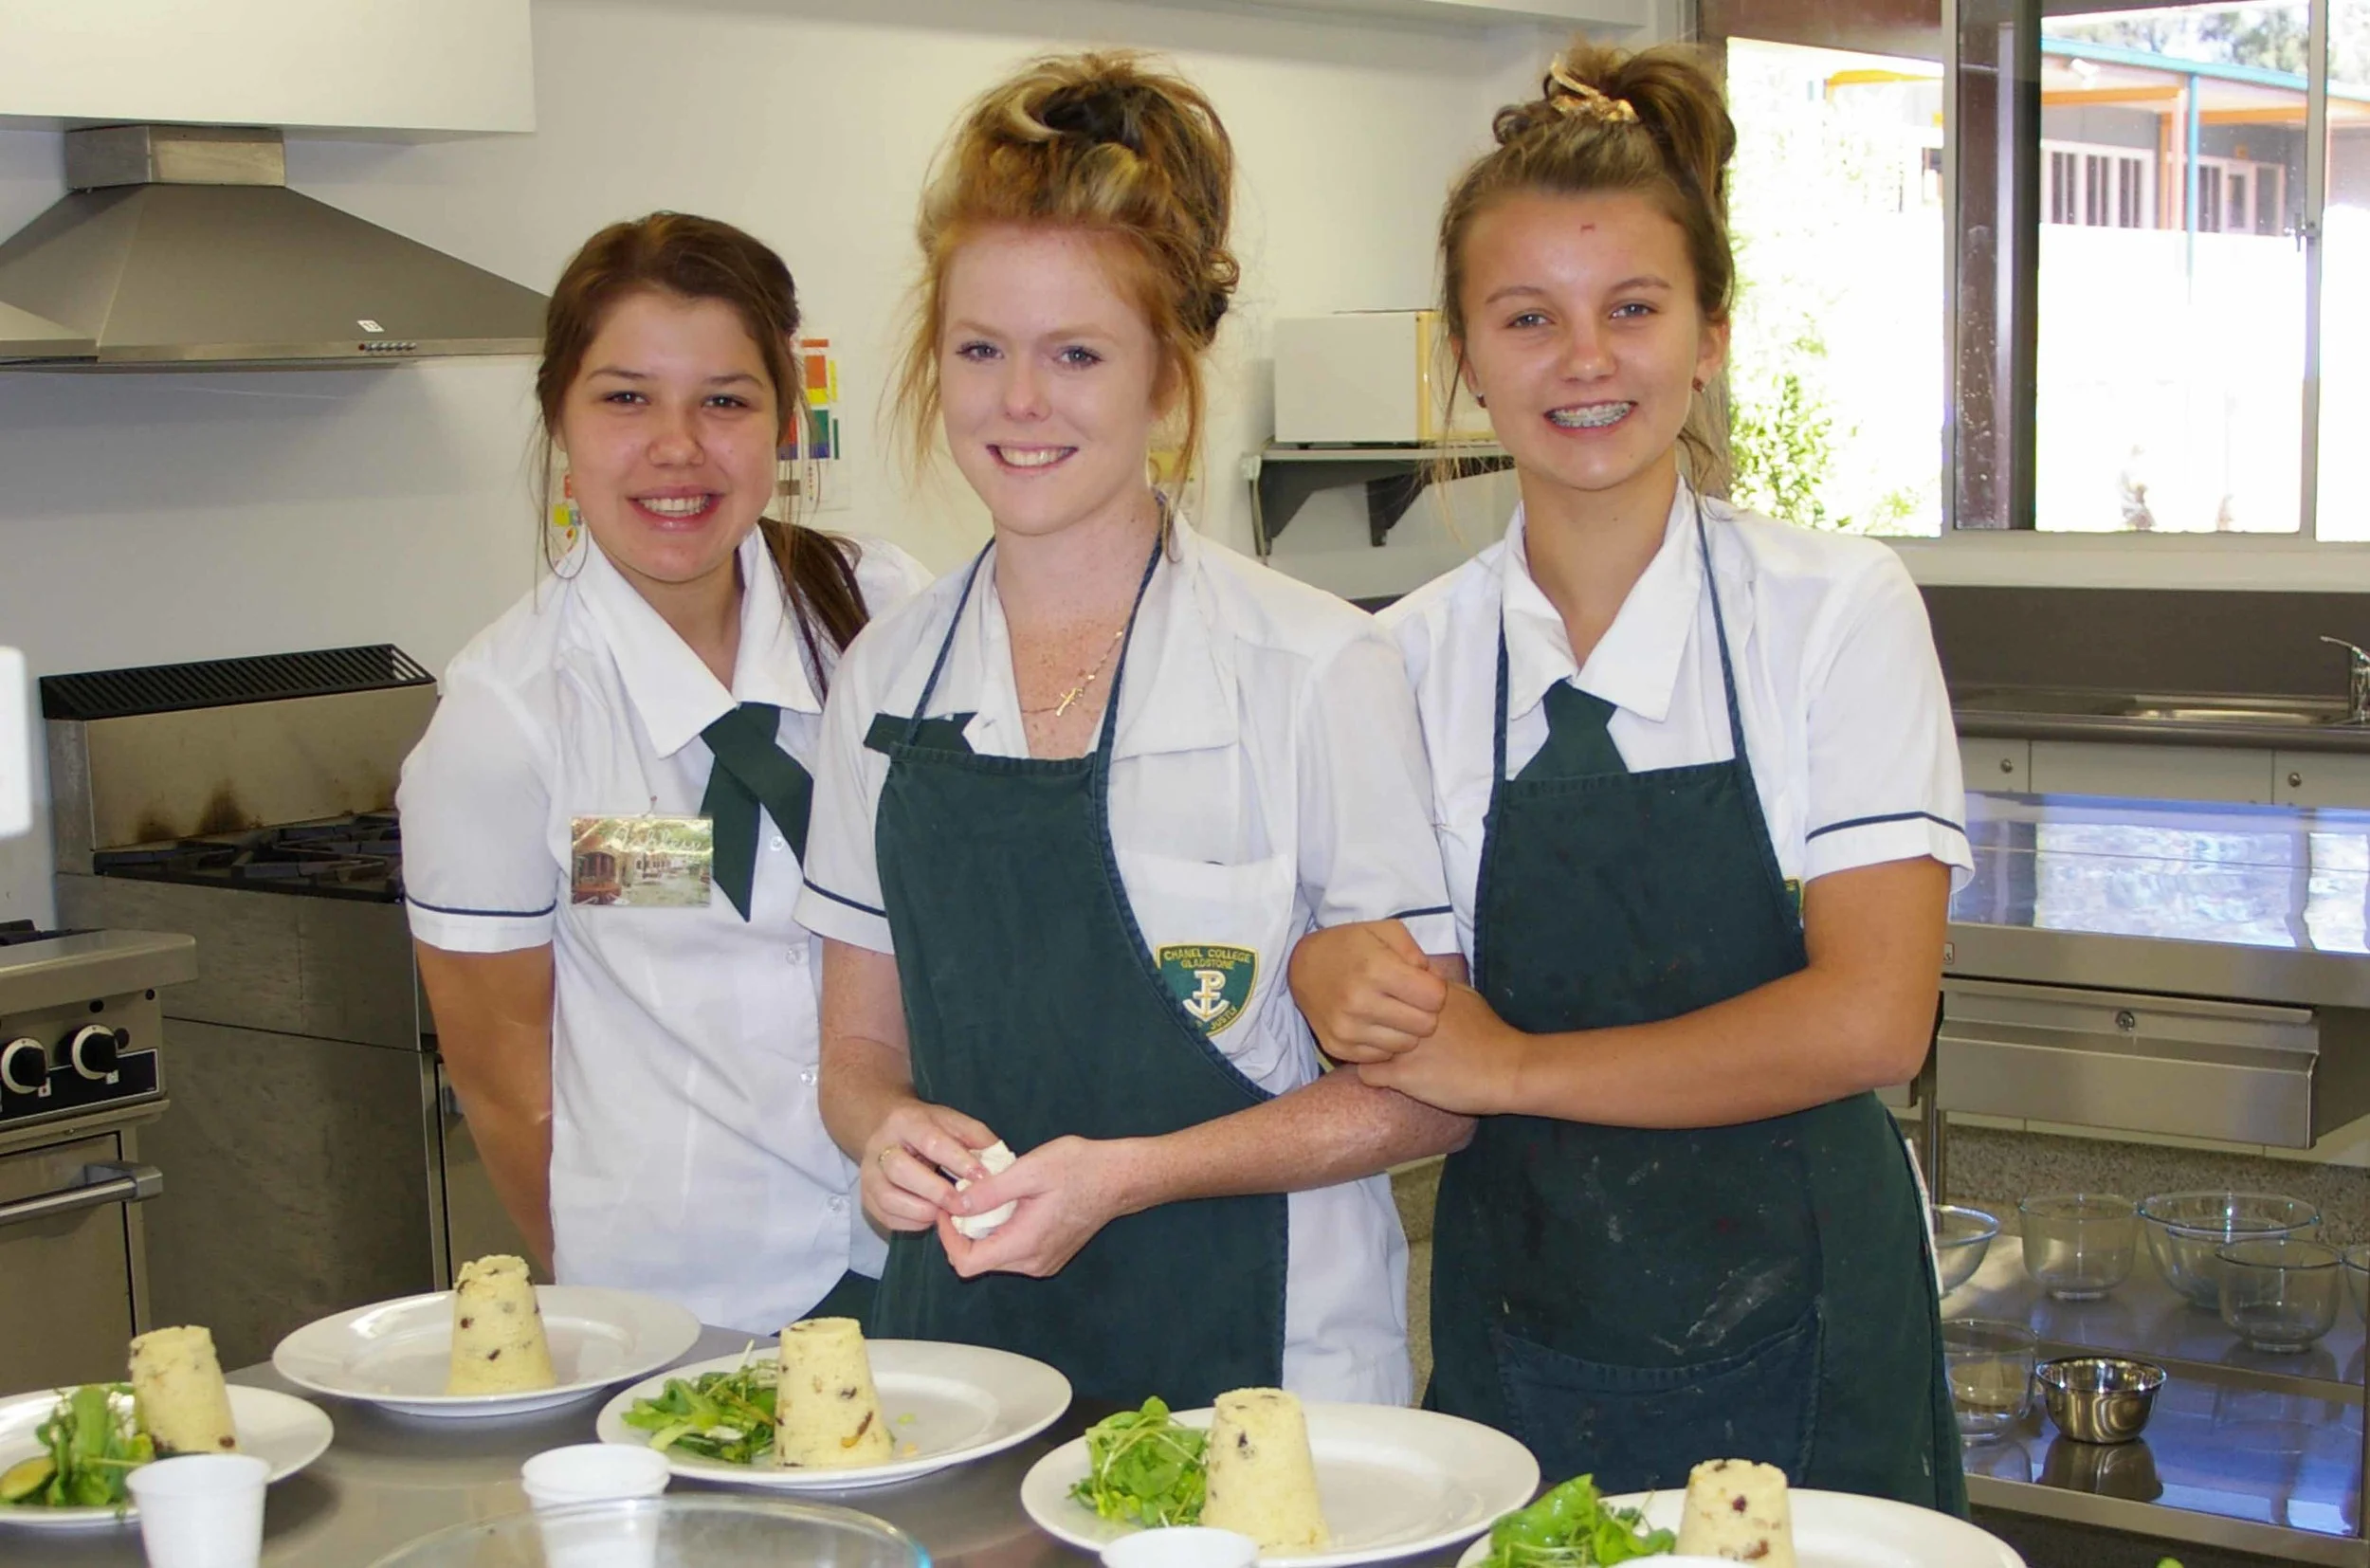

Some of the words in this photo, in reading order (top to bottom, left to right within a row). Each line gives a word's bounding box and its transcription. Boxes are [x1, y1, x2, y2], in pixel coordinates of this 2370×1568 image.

[1163, 948, 1203, 960] CHANEL
[1207, 949, 1251, 963] COLLEGE
[1180, 958, 1234, 970] GLADSTONE
[1210, 1005, 1239, 1030] JUSTLY
